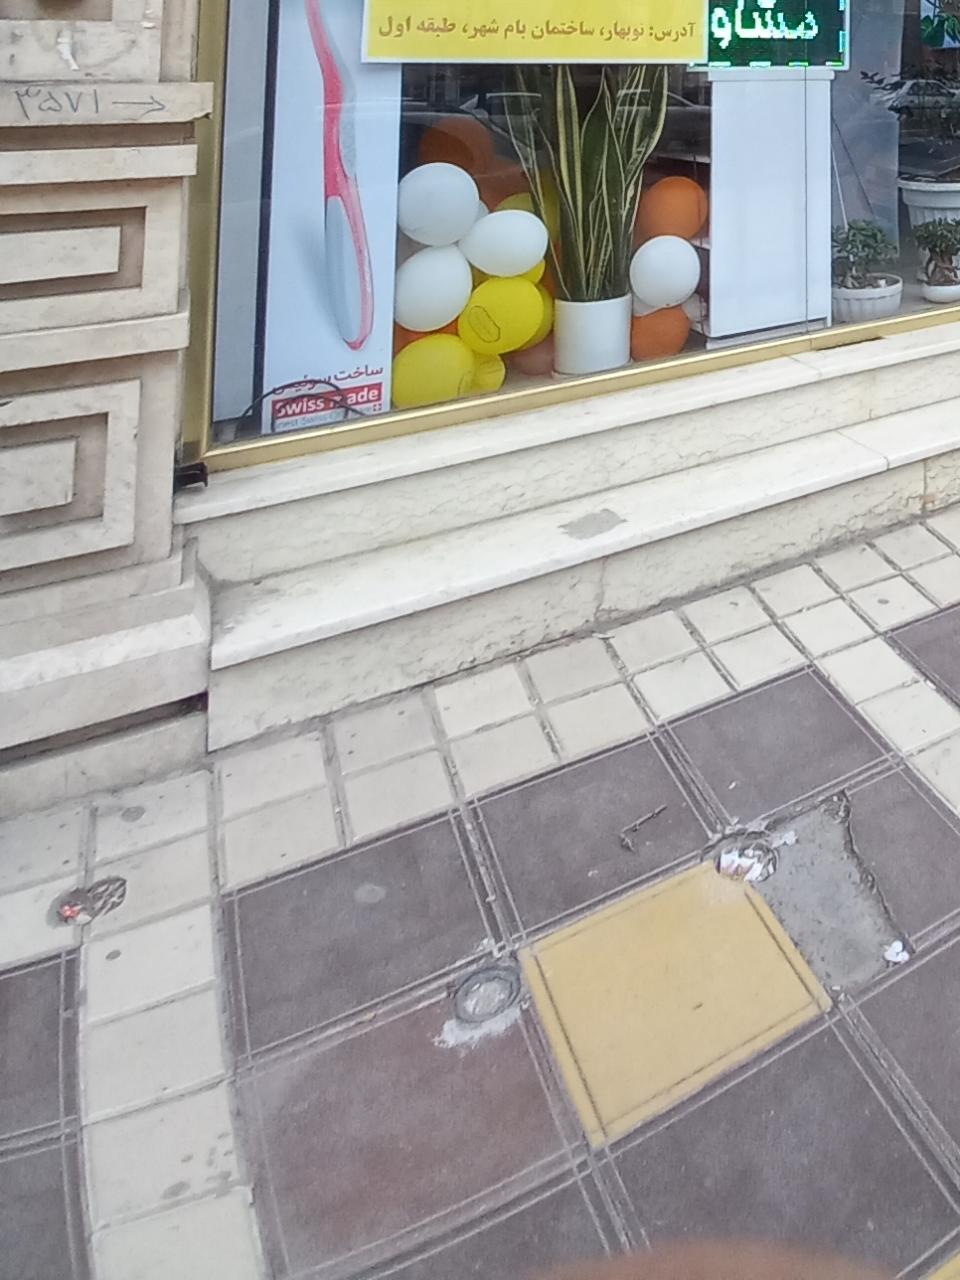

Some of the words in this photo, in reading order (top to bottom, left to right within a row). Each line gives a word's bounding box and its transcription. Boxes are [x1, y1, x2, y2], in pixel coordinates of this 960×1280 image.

[379, 16, 412, 38] اول
[416, 17, 457, 38] طبقه
[504, 19, 527, 40] بام
[531, 20, 595, 39] ساختمان
[649, 22, 696, 42] آدرس:
[333, 365, 383, 382] ساخت
